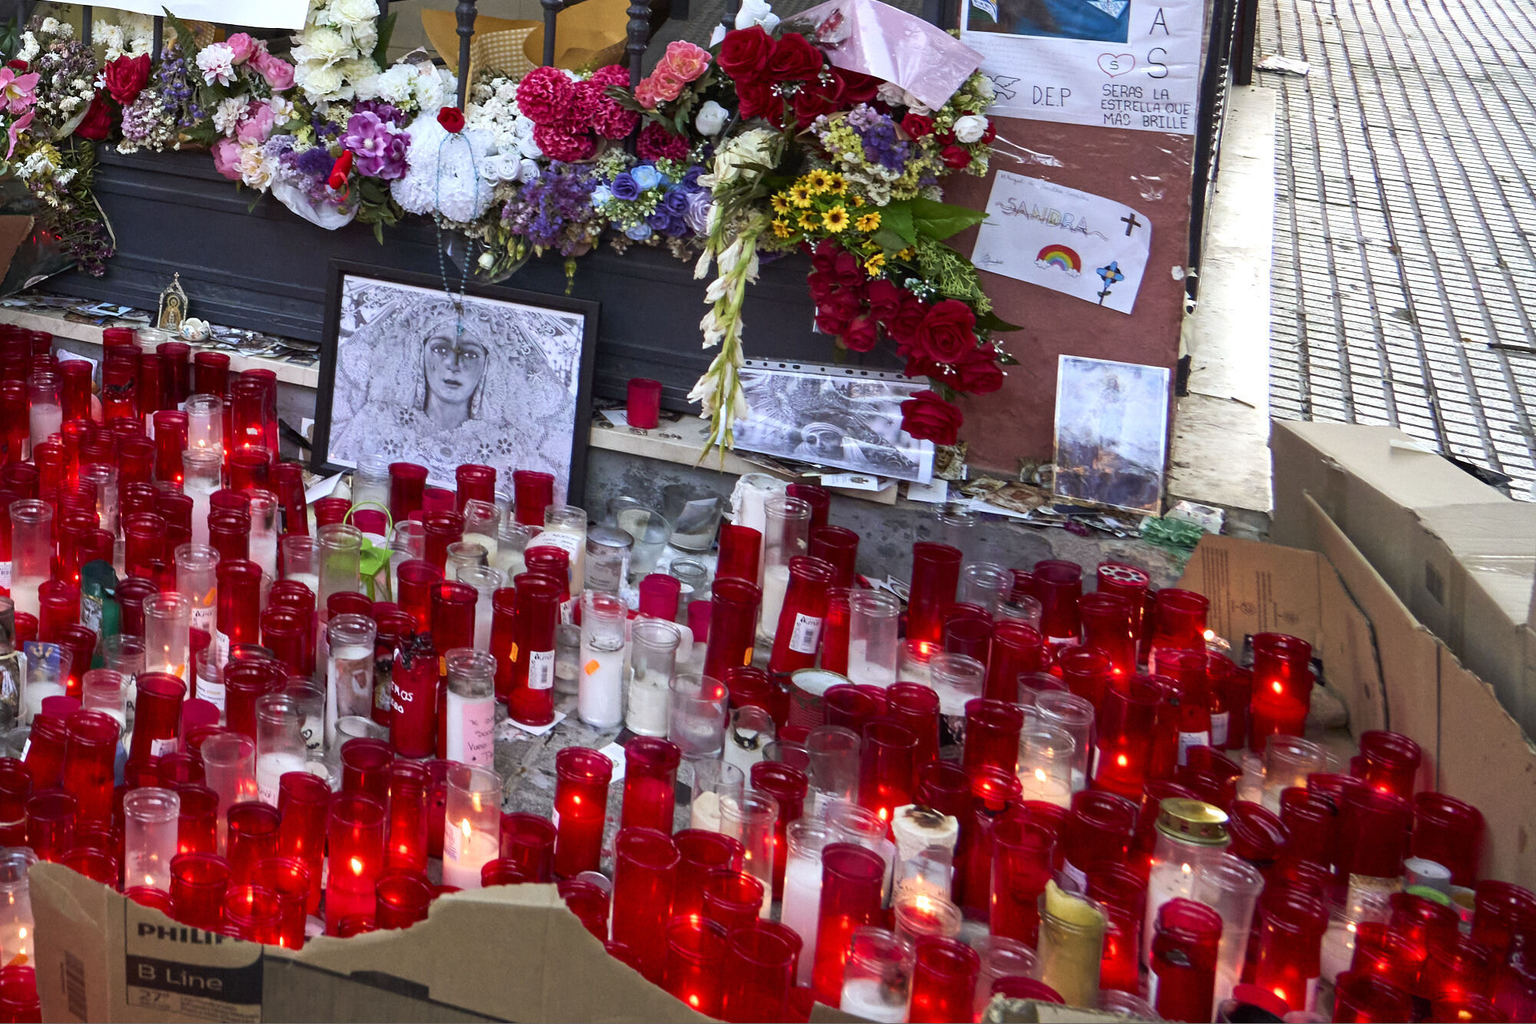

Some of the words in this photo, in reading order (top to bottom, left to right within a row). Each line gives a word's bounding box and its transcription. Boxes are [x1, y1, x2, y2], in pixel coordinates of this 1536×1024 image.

[1102, 83, 1144, 100] SERAS
[1152, 88, 1170, 101] LA
[1100, 99, 1162, 114] ESTRELLA
[1165, 102, 1190, 116] QUE
[1142, 114, 1188, 130] BRILLE
[1007, 197, 1089, 233] SANDRA
[138, 922, 243, 944] PHILI
[138, 963, 156, 980] B
[166, 968, 223, 991] Line
